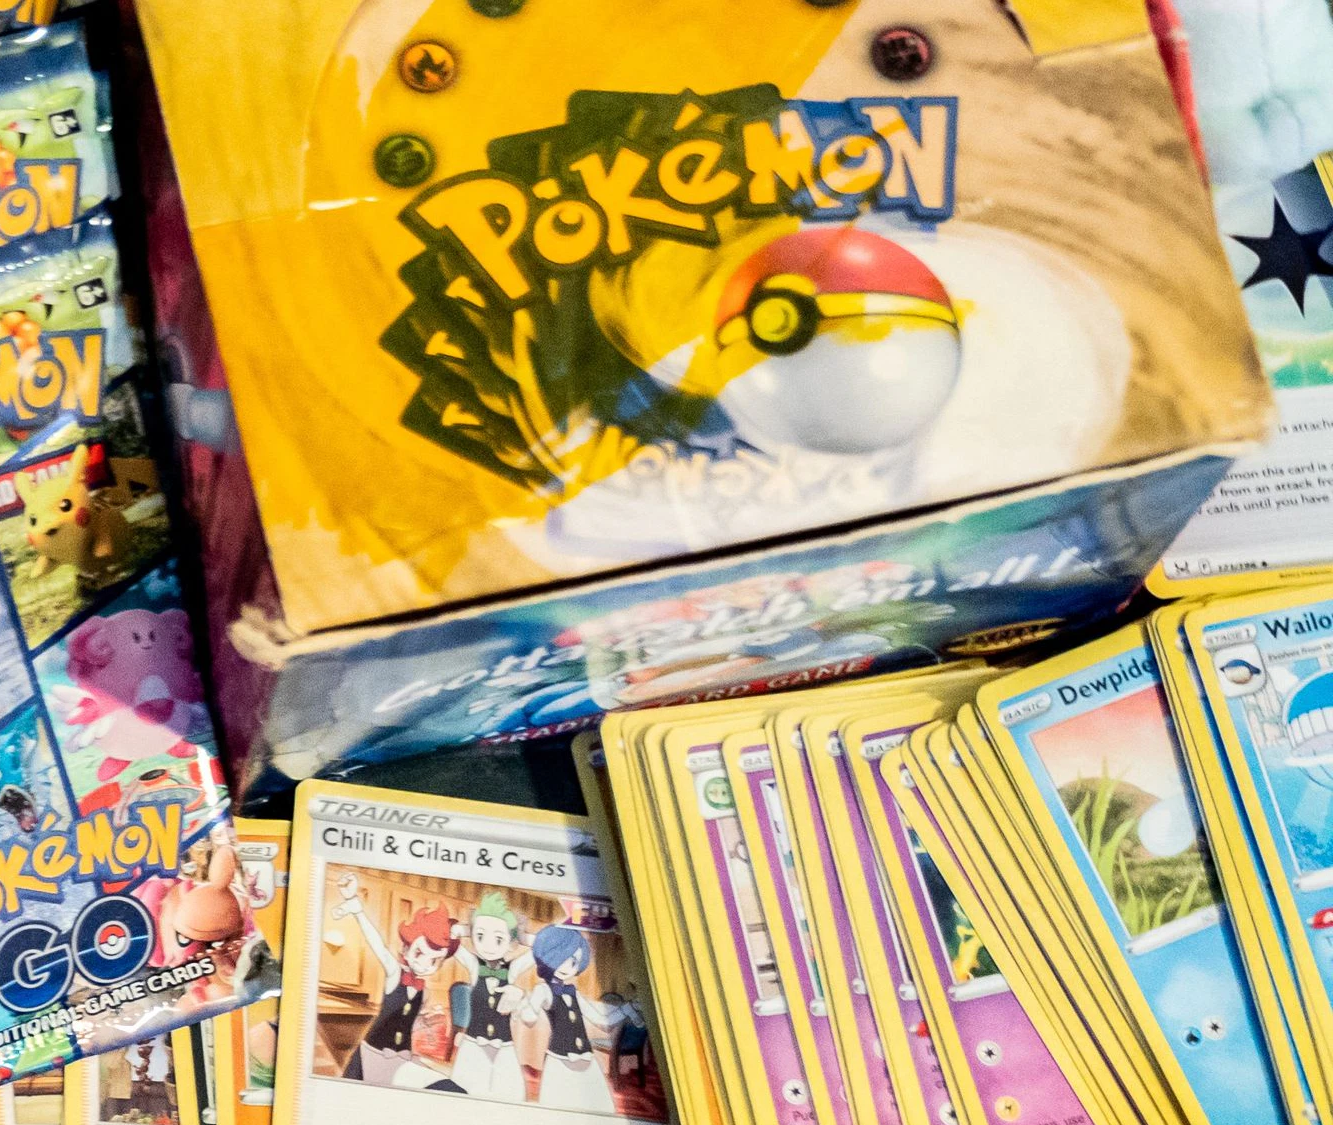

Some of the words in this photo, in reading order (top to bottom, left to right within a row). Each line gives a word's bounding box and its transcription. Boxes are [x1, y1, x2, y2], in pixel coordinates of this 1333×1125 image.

[1288, 462, 1315, 476] card
[1206, 503, 1241, 517] cards
[1275, 496, 1300, 510] you
[1300, 493, 1330, 506] have
[1262, 611, 1333, 641] Wailo
[316, 798, 451, 831] TRAINER
[321, 826, 376, 854] Chili
[384, 834, 400, 856] &
[408, 838, 469, 867] Cilan
[476, 846, 494, 869] &
[501, 851, 568, 880] Cress
[84, 980, 146, 1017] GAME
[147, 958, 216, 995] CARDS
